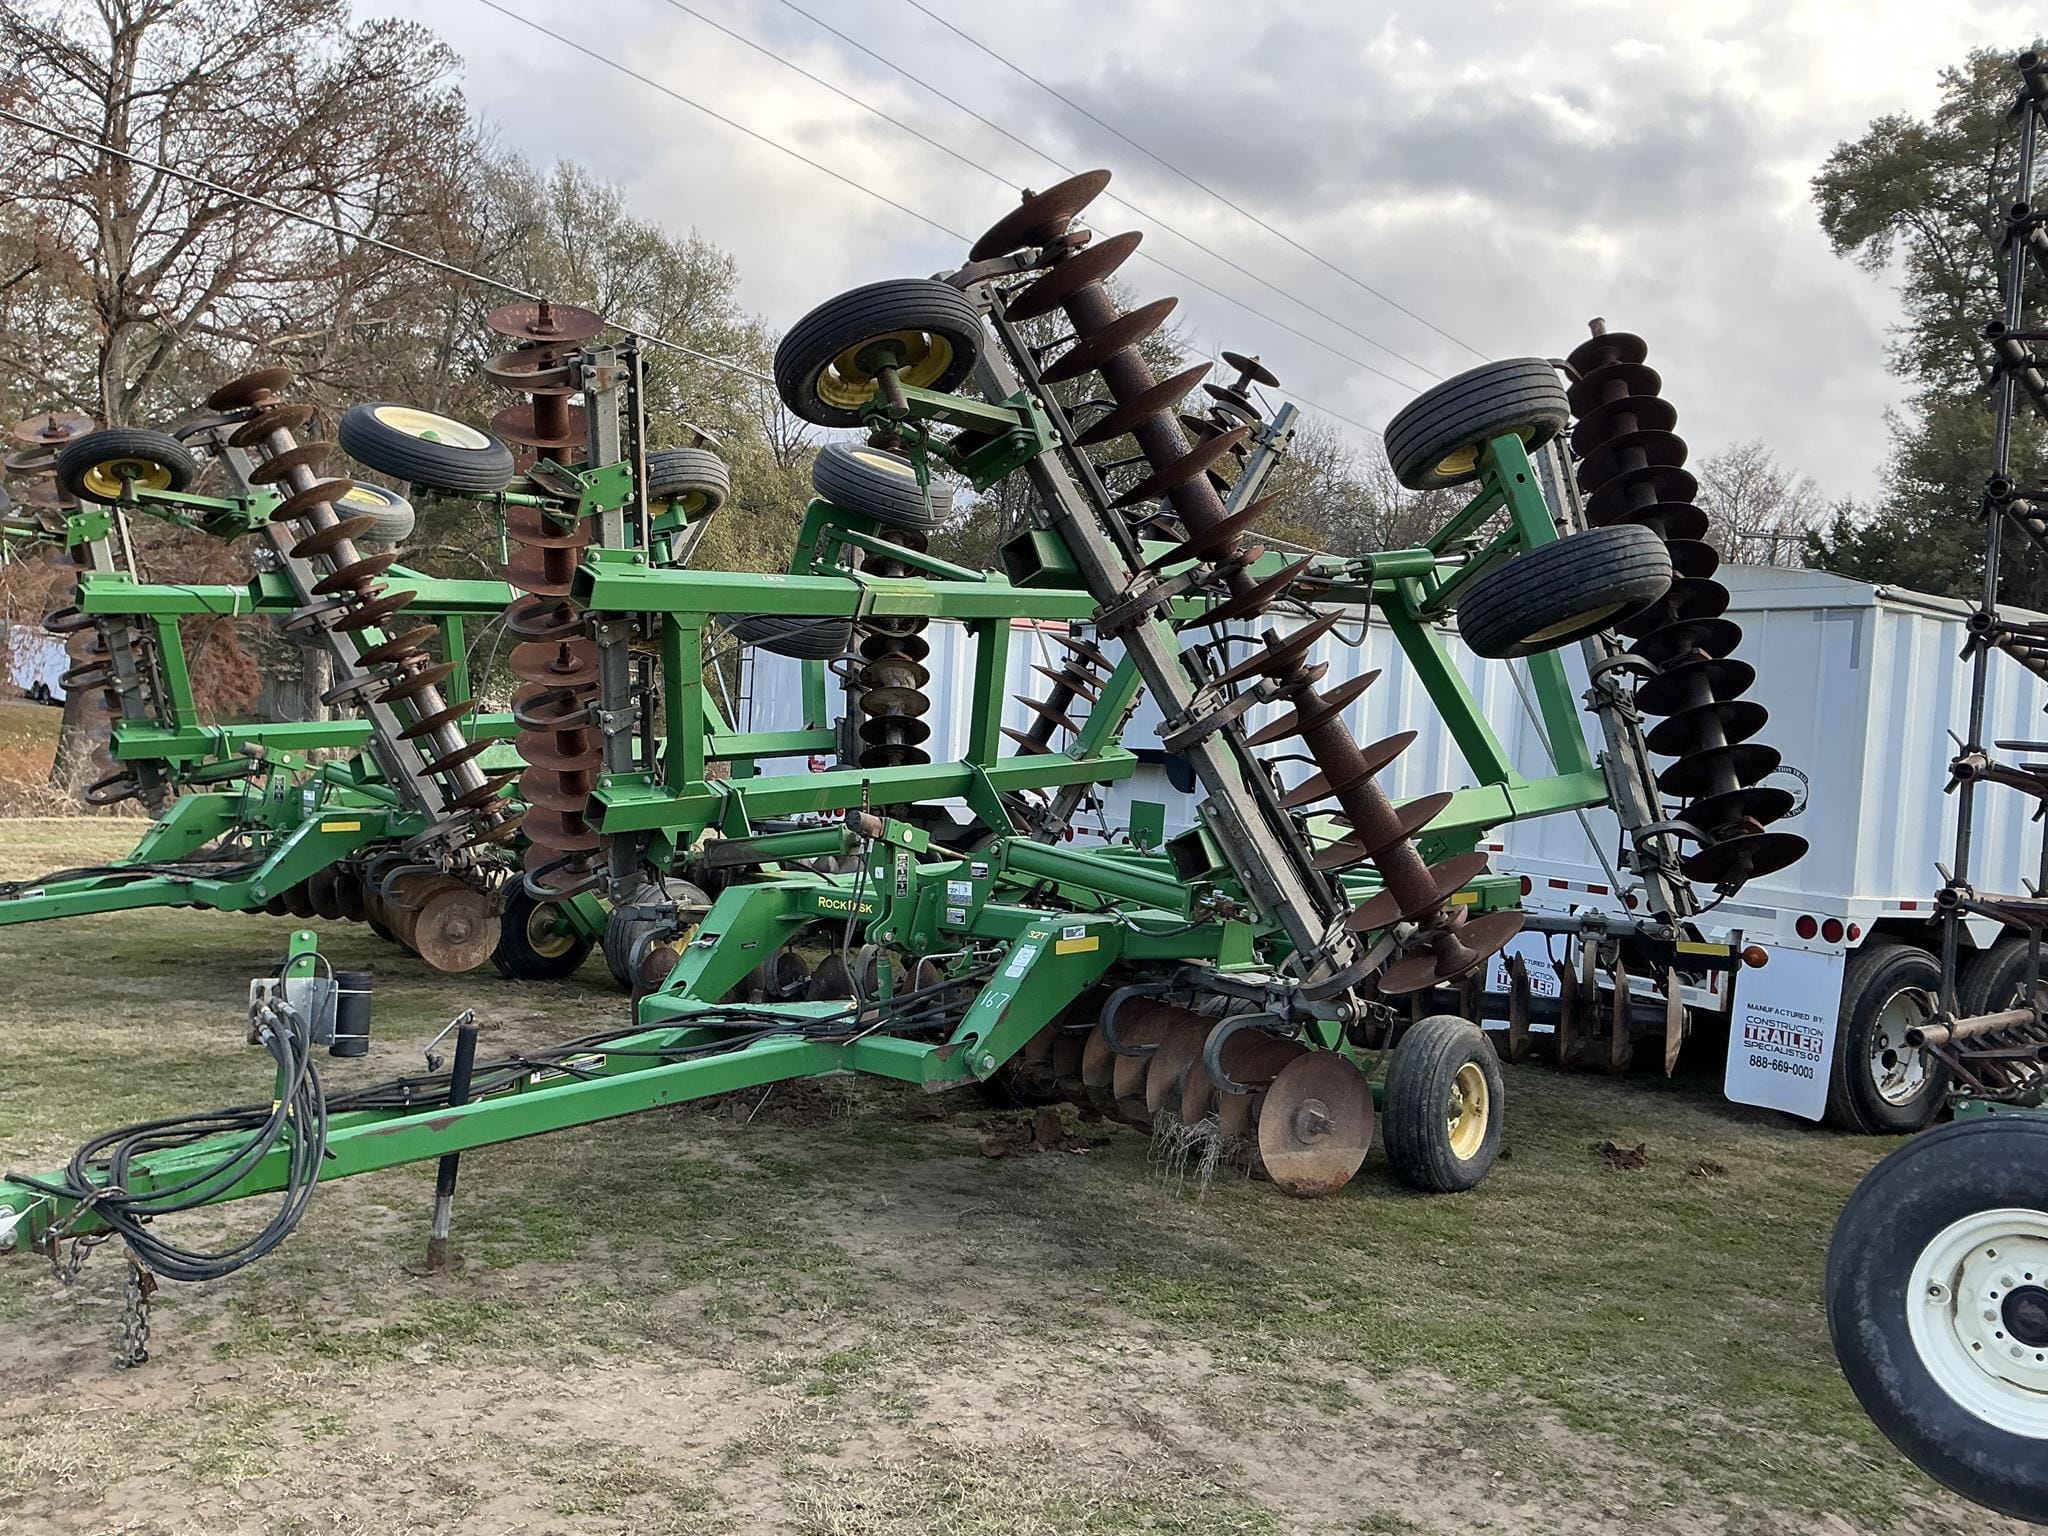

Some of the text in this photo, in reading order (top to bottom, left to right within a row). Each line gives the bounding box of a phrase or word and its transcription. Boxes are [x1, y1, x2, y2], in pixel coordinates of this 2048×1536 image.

[818, 896, 873, 914] ROCKDSK
[980, 990, 1010, 1010] 167
[1747, 1003, 1825, 1025] MANUFACTURED BY:
[1746, 1015, 1824, 1037] CONSTRUCTION
[1745, 1023, 1823, 1055] TRAILER
[1749, 1054, 1814, 1080] 888-669-0003
